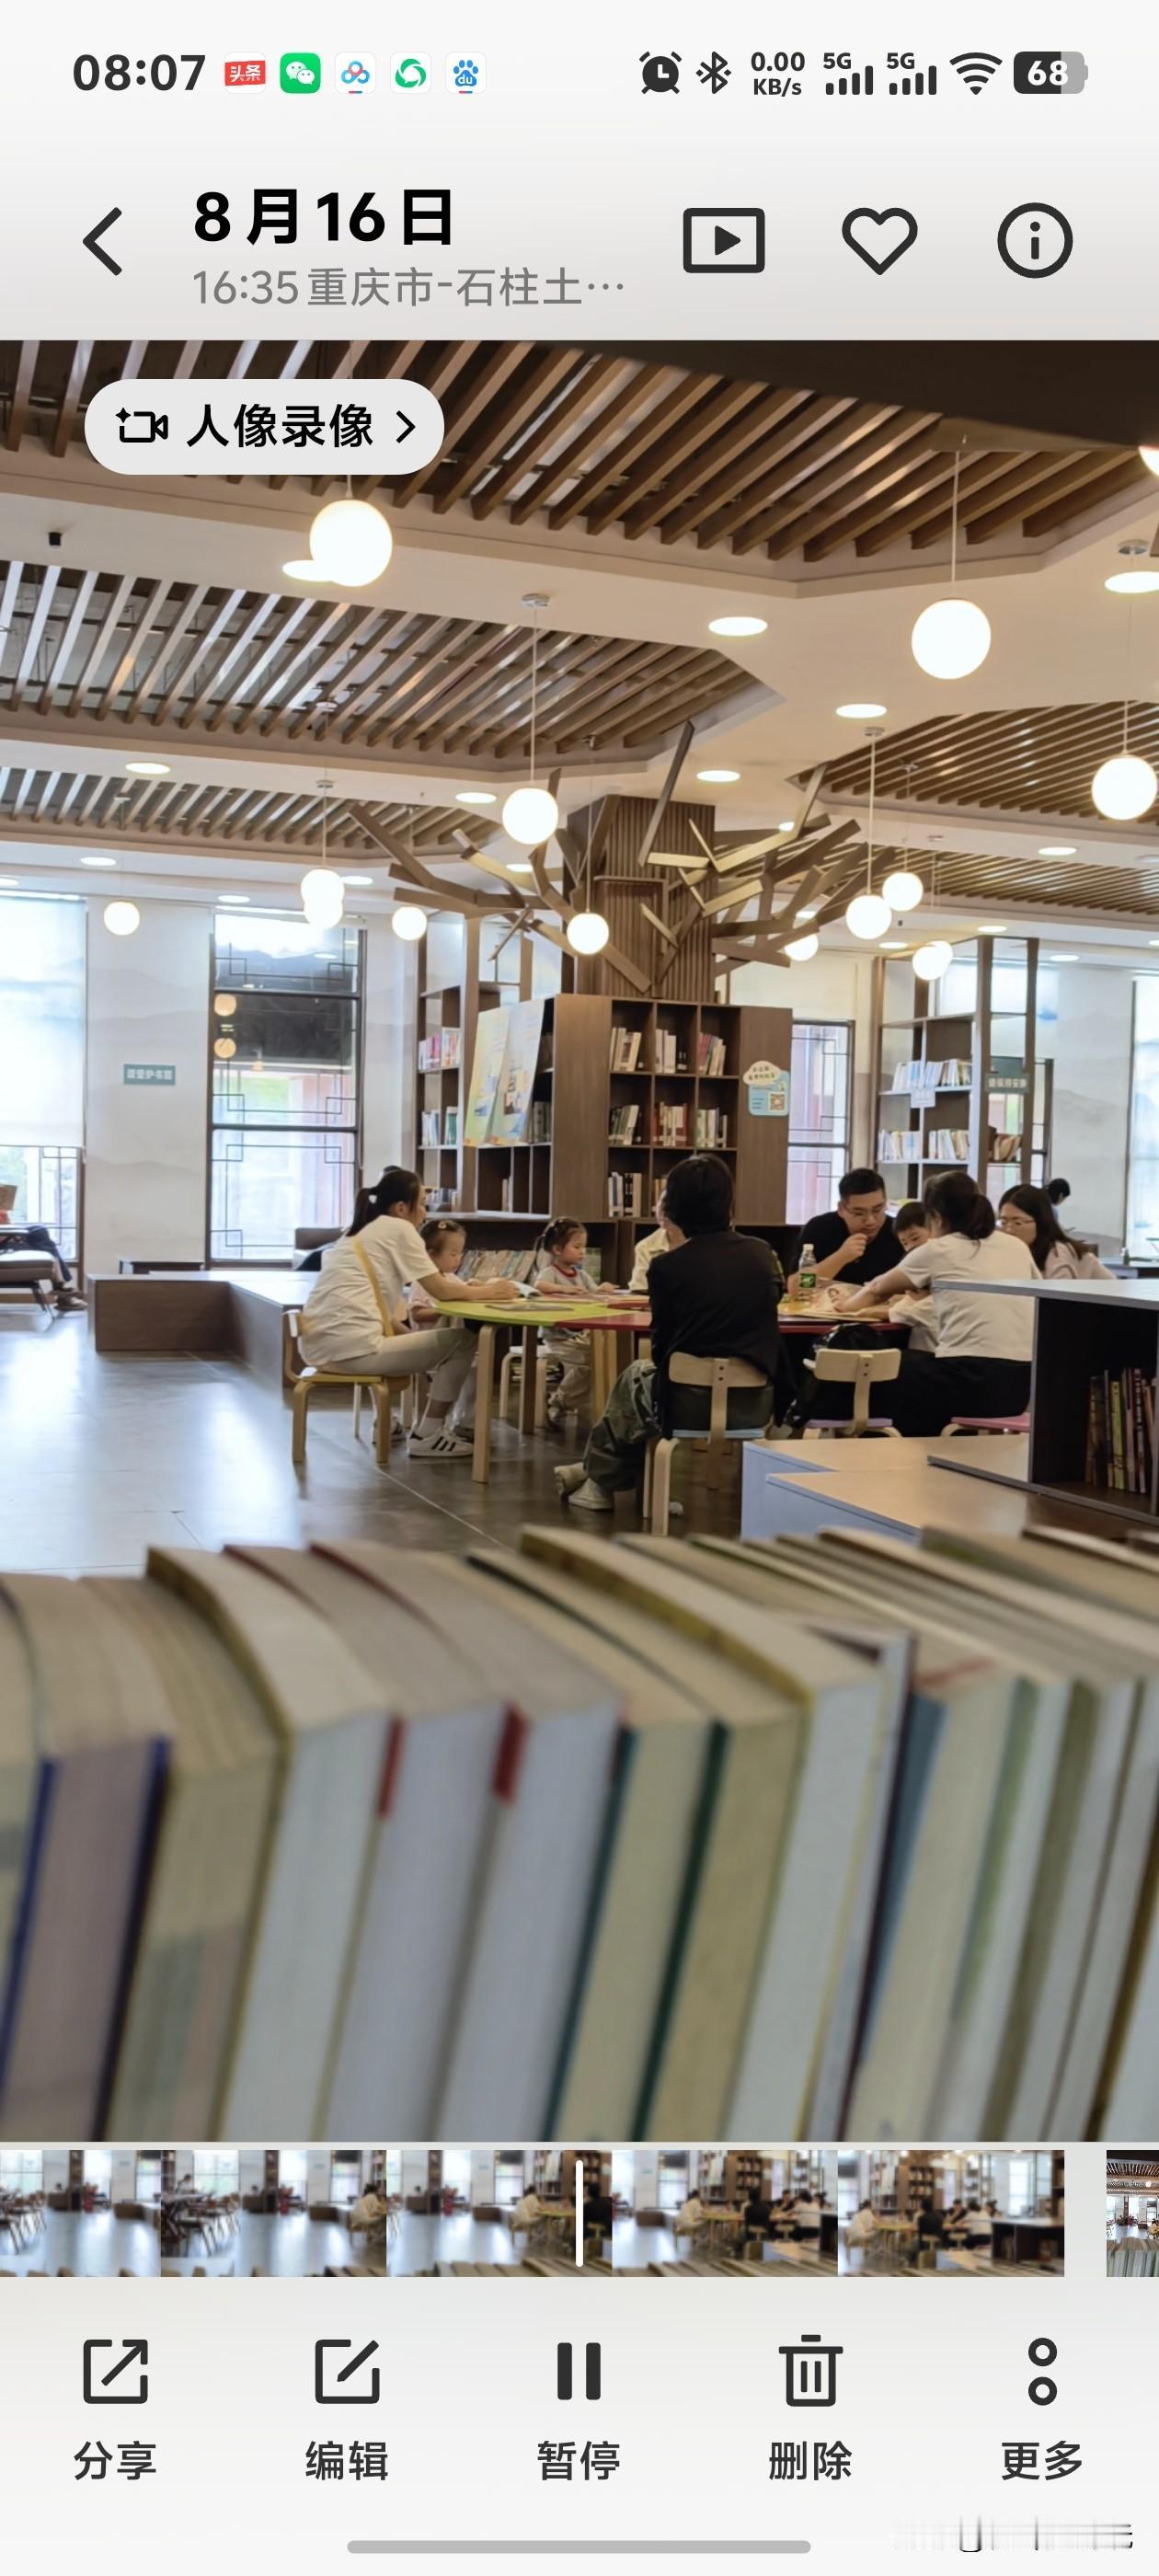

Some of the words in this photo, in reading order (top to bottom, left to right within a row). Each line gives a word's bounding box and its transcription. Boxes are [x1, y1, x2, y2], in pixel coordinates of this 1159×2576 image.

[73, 53, 207, 91] 08:07
[229, 64, 261, 83] 头条
[750, 52, 807, 72] 0.00
[822, 52, 852, 70] 5G
[886, 52, 915, 70] 5G
[1027, 60, 1070, 86] 68
[752, 77, 803, 97] KB/s
[194, 188, 453, 246] 8月16日
[186, 403, 373, 448] 人像录像
[73, 2440, 156, 2481] 分享
[304, 2440, 389, 2481] 编辑
[537, 2440, 620, 2481] 暂停
[768, 2440, 853, 2481] 删除
[1001, 2440, 1083, 2481] 更多
